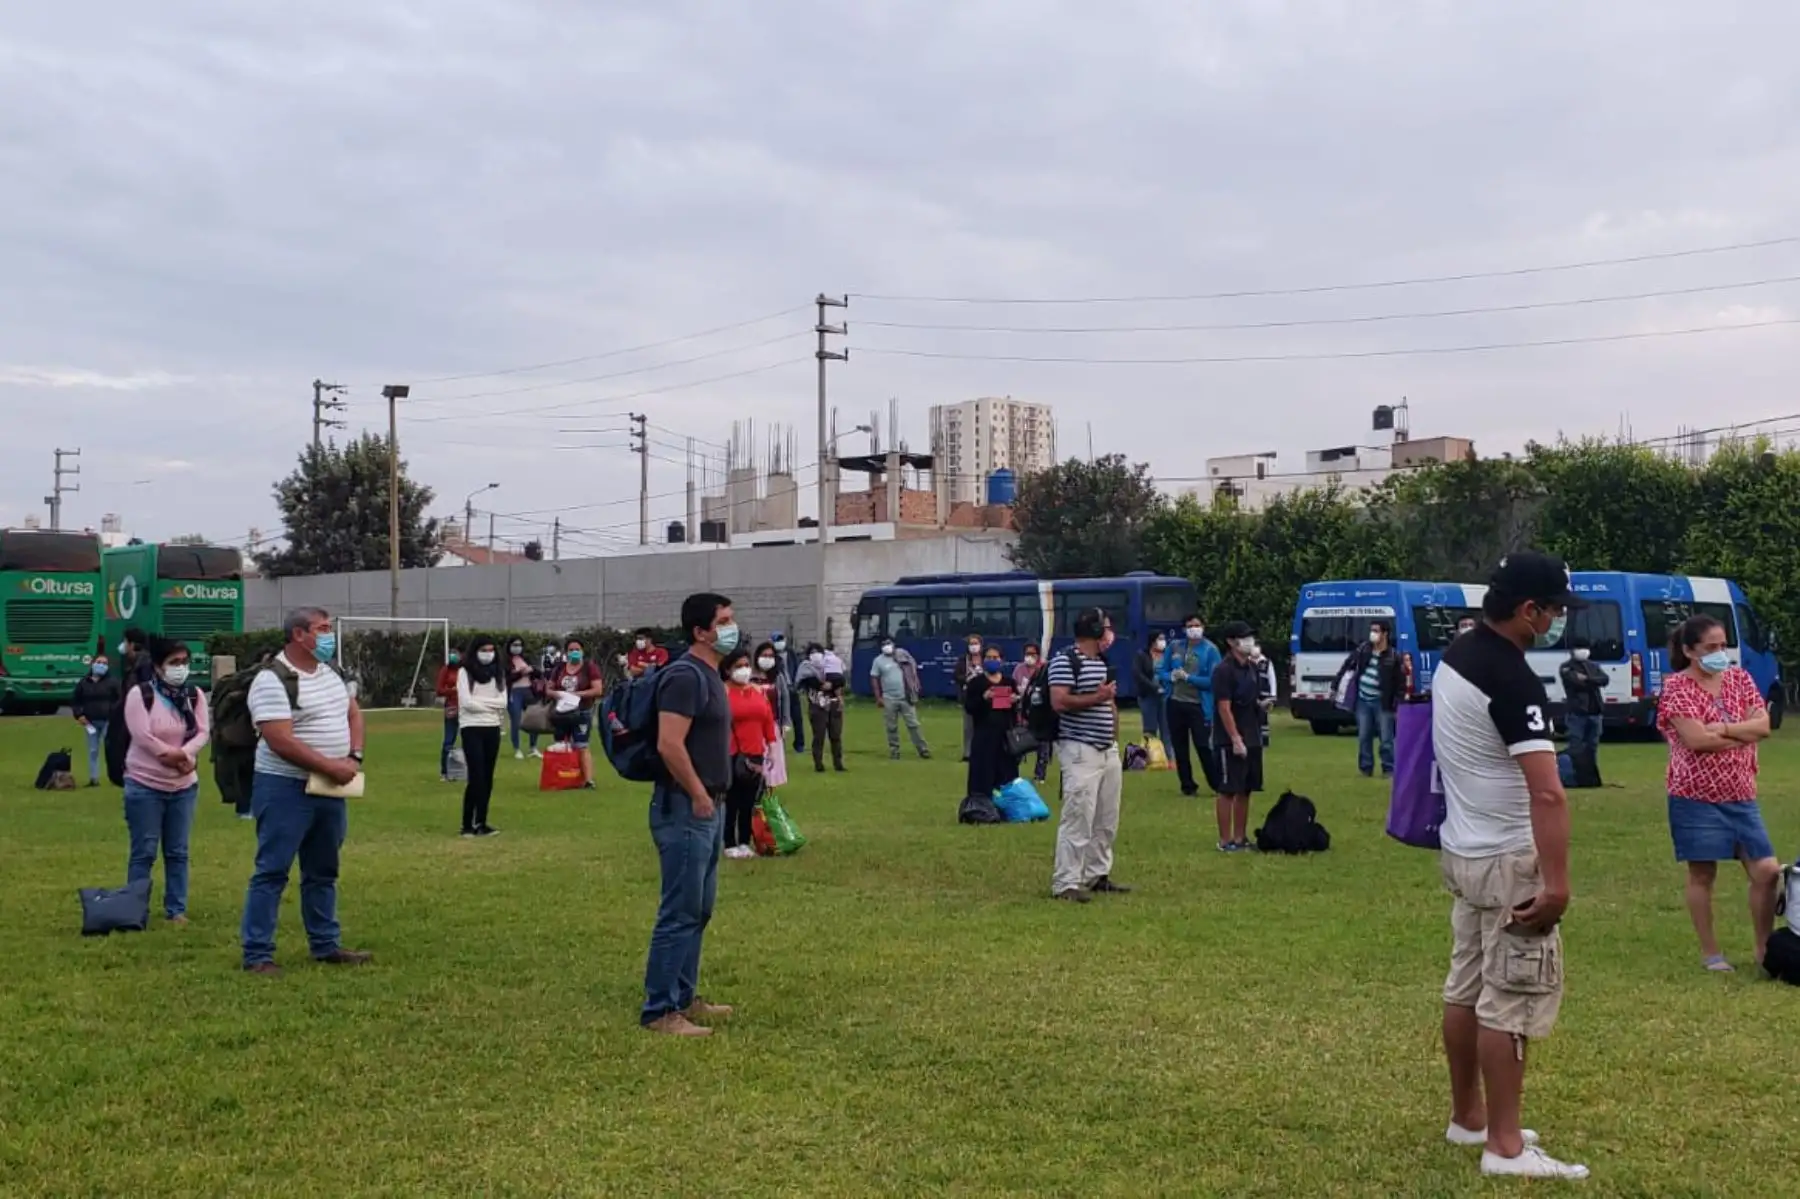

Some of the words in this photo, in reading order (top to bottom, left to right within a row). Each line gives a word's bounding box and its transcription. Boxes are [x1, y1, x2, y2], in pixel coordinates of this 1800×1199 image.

[31, 578, 94, 595] Oltursa
[183, 584, 239, 600] Oltursa
[1420, 652, 1430, 670] 11
[1649, 651, 1660, 670] 11
[1526, 705, 1545, 731] 3
